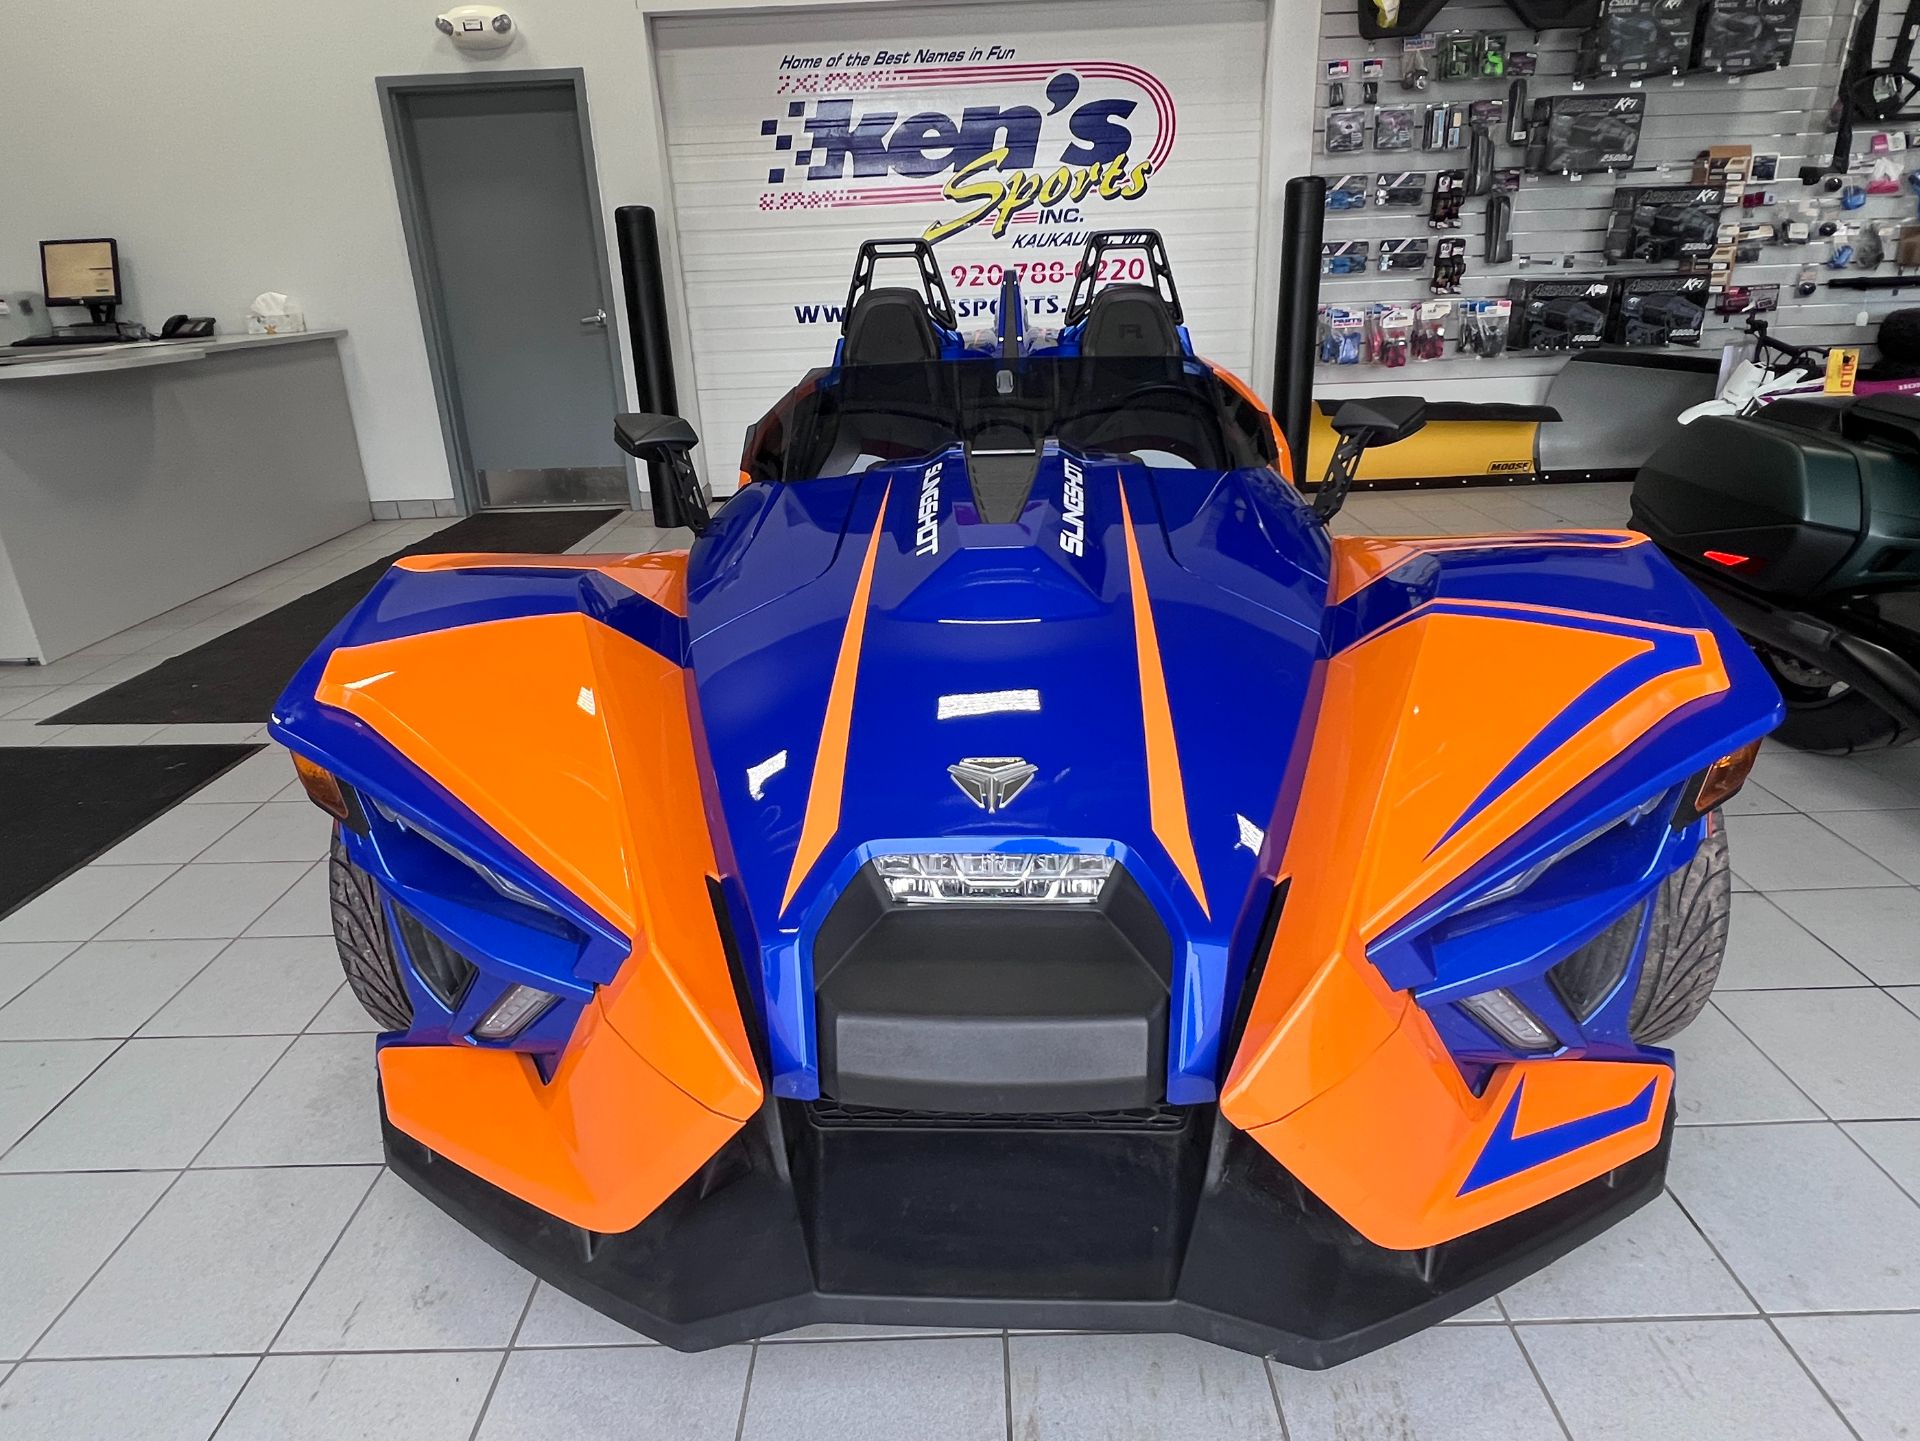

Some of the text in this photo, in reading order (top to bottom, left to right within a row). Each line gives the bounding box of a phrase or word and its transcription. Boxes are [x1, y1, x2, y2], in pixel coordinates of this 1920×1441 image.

[779, 45, 1016, 70] Home of the Best Names in Fun
[1614, 97, 1638, 111] KFI
[922, 147, 1153, 244] Sports
[1696, 189, 1719, 202] KFI
[1038, 208, 1084, 225] INC.
[1682, 278, 1706, 292] KFI
[1491, 462, 1529, 471] MOOSE
[915, 462, 943, 557] SLINGSHOT
[1059, 458, 1085, 558] SLINGSHOT
